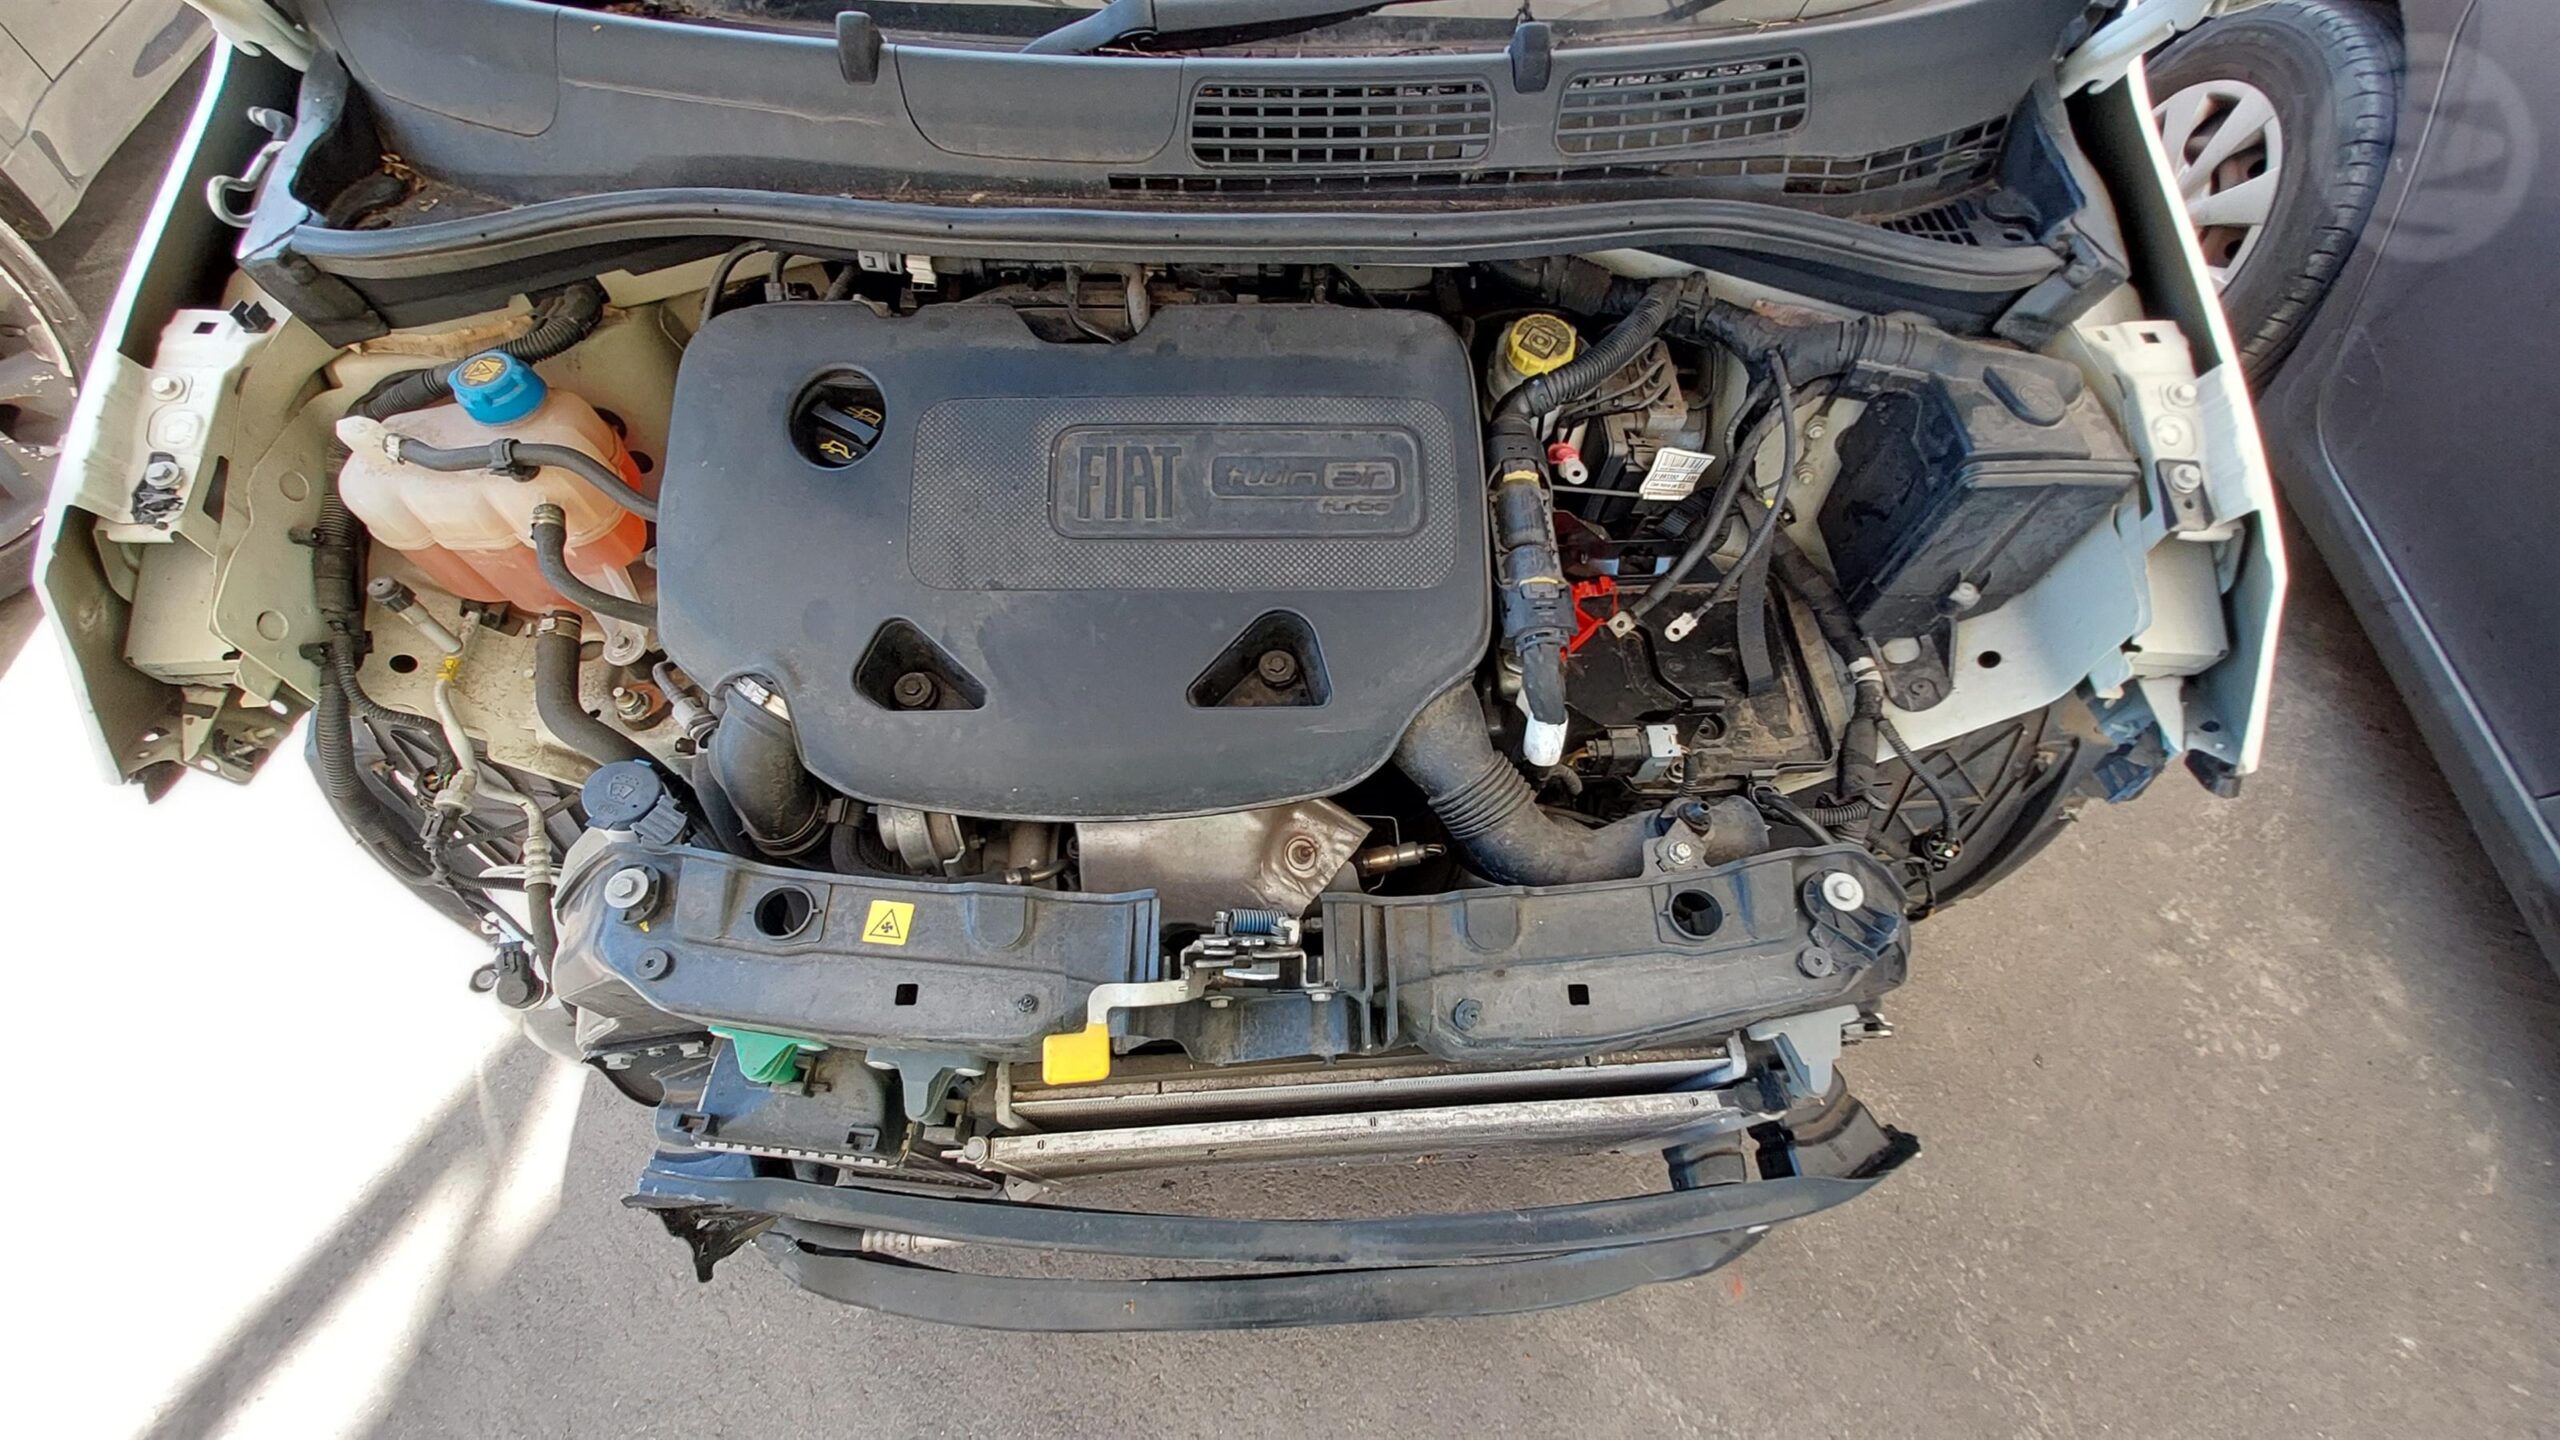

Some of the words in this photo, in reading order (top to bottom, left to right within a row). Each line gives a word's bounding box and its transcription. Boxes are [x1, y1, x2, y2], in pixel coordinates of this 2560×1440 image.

[1078, 446, 1182, 519] FIAT
[1228, 466, 1317, 487] twin
[1321, 500, 1391, 513] turbo
